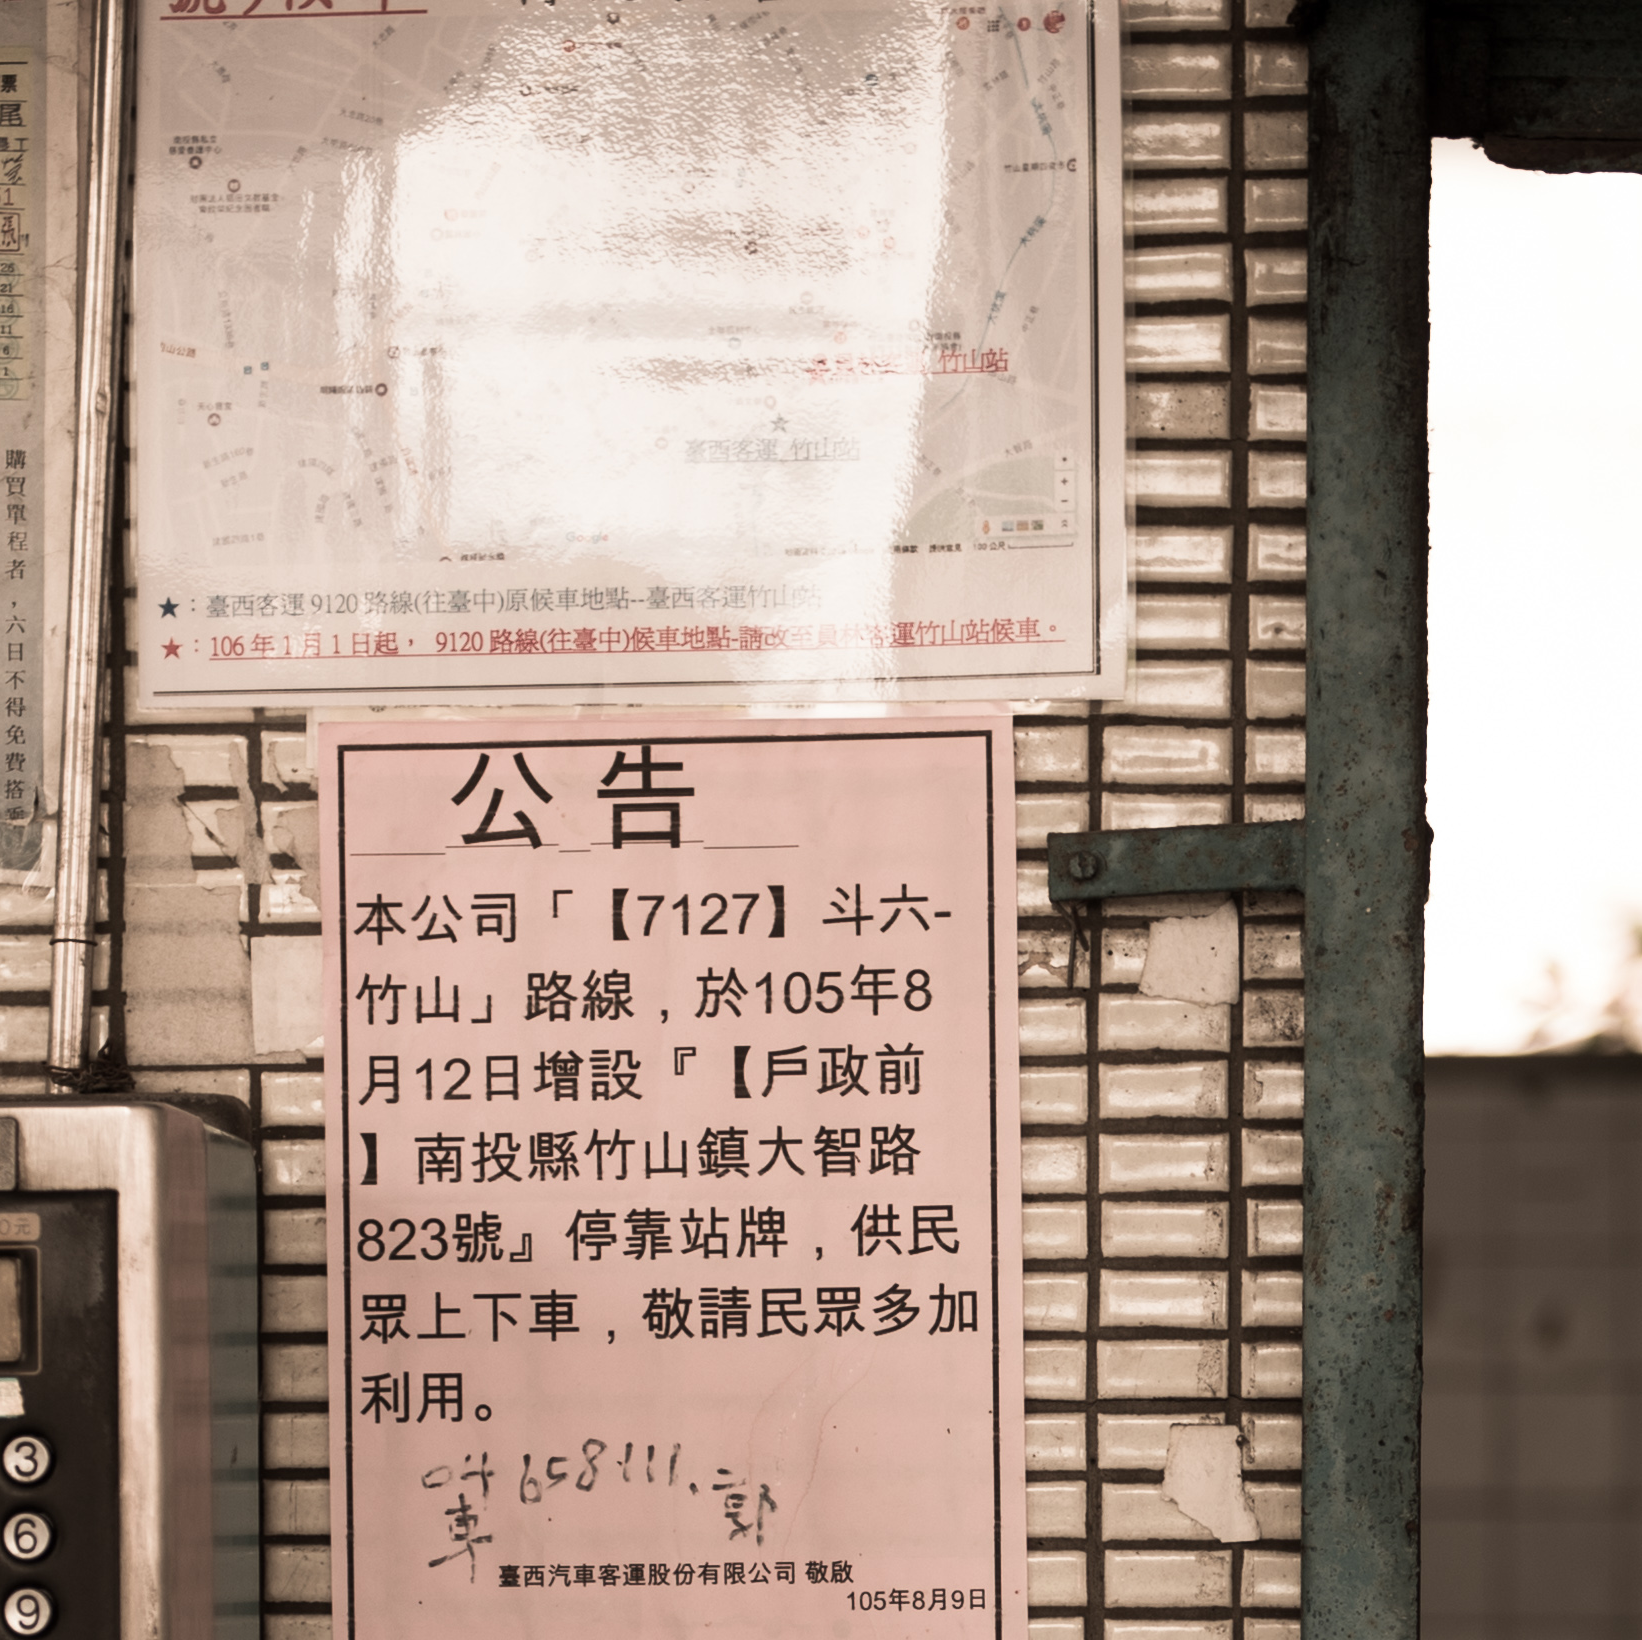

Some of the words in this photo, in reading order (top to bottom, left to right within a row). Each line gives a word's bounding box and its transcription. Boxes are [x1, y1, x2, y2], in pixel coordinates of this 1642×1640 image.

[451, 745, 695, 850] 公告
[360, 1371, 493, 1424] 利用。
[14, 1440, 39, 1478] 3
[13, 1518, 38, 1554] 6
[498, 1560, 797, 1589] 臺西汽車客運股份有限公司
[805, 1559, 855, 1586] 敬啟
[16, 1594, 41, 1630] 9
[845, 1587, 987, 1613] 105年8月9日
